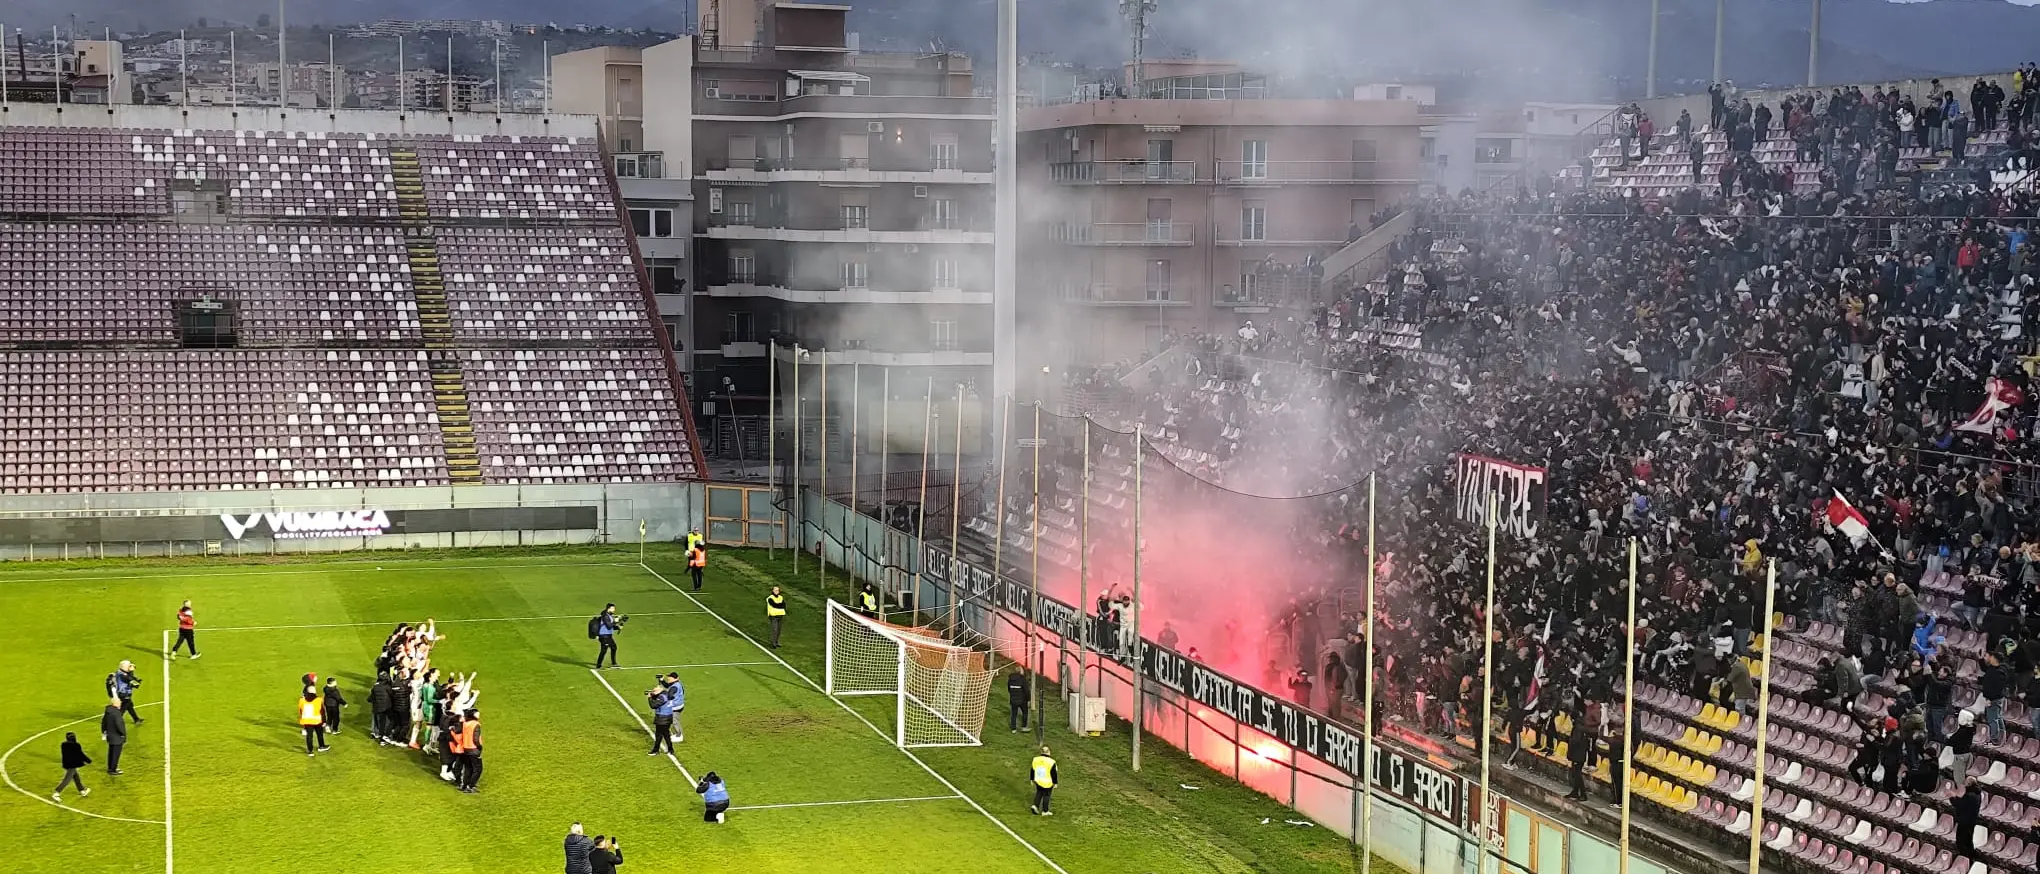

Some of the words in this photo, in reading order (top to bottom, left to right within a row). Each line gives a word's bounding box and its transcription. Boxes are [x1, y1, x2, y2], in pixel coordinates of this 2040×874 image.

[265, 509, 391, 532] VUMBACA
[1154, 648, 1185, 693] NELLE
[1282, 705, 1298, 747] TU
